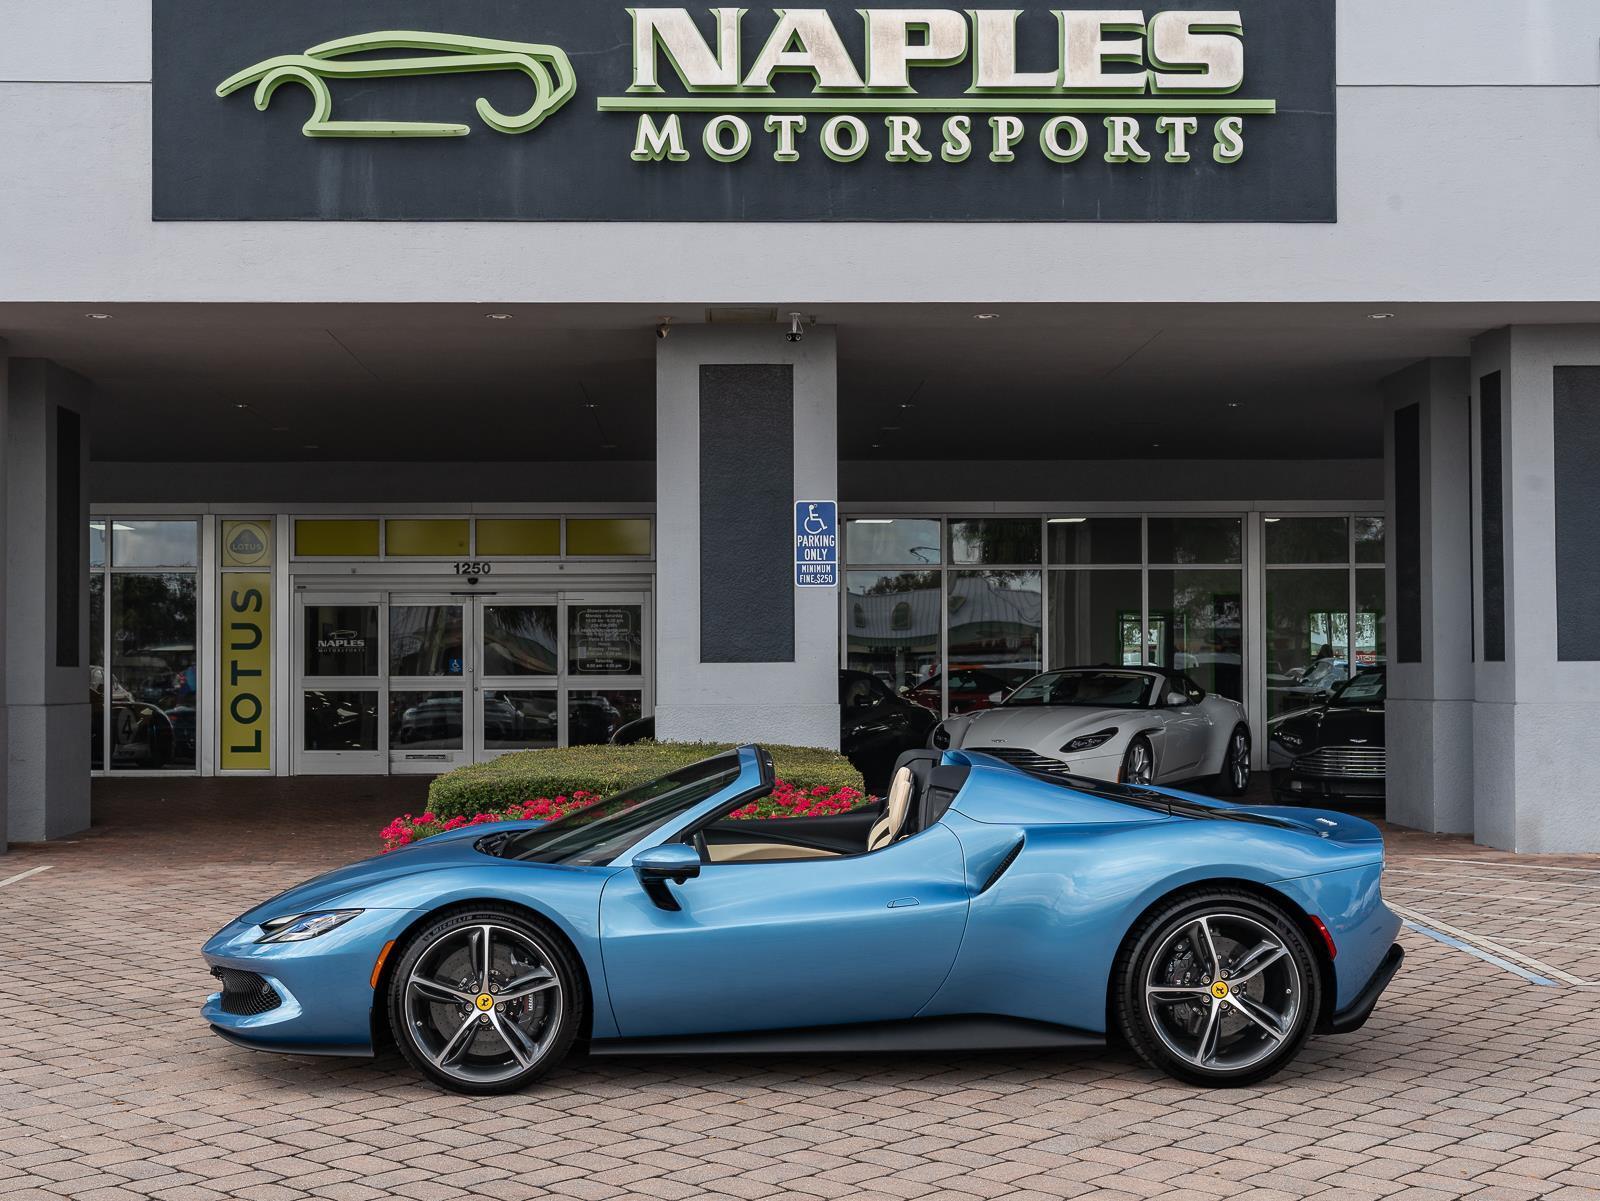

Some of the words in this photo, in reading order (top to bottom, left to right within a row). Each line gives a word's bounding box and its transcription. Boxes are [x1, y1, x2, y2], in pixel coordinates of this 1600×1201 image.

[625, 8, 1245, 94] NAPLES
[630, 114, 1244, 163] MOTORSPORTS
[232, 543, 262, 551] LOTUS
[797, 535, 835, 547] PARKING
[804, 548, 828, 561] ONLY
[454, 562, 491, 575] 1250
[801, 564, 831, 573] MINIMUM
[799, 574, 815, 583] FINE
[816, 574, 833, 584] $250
[317, 639, 365, 647] NAPLES
[230, 588, 263, 753] LOTUS
[432, 915, 473, 935] MICHELIN
